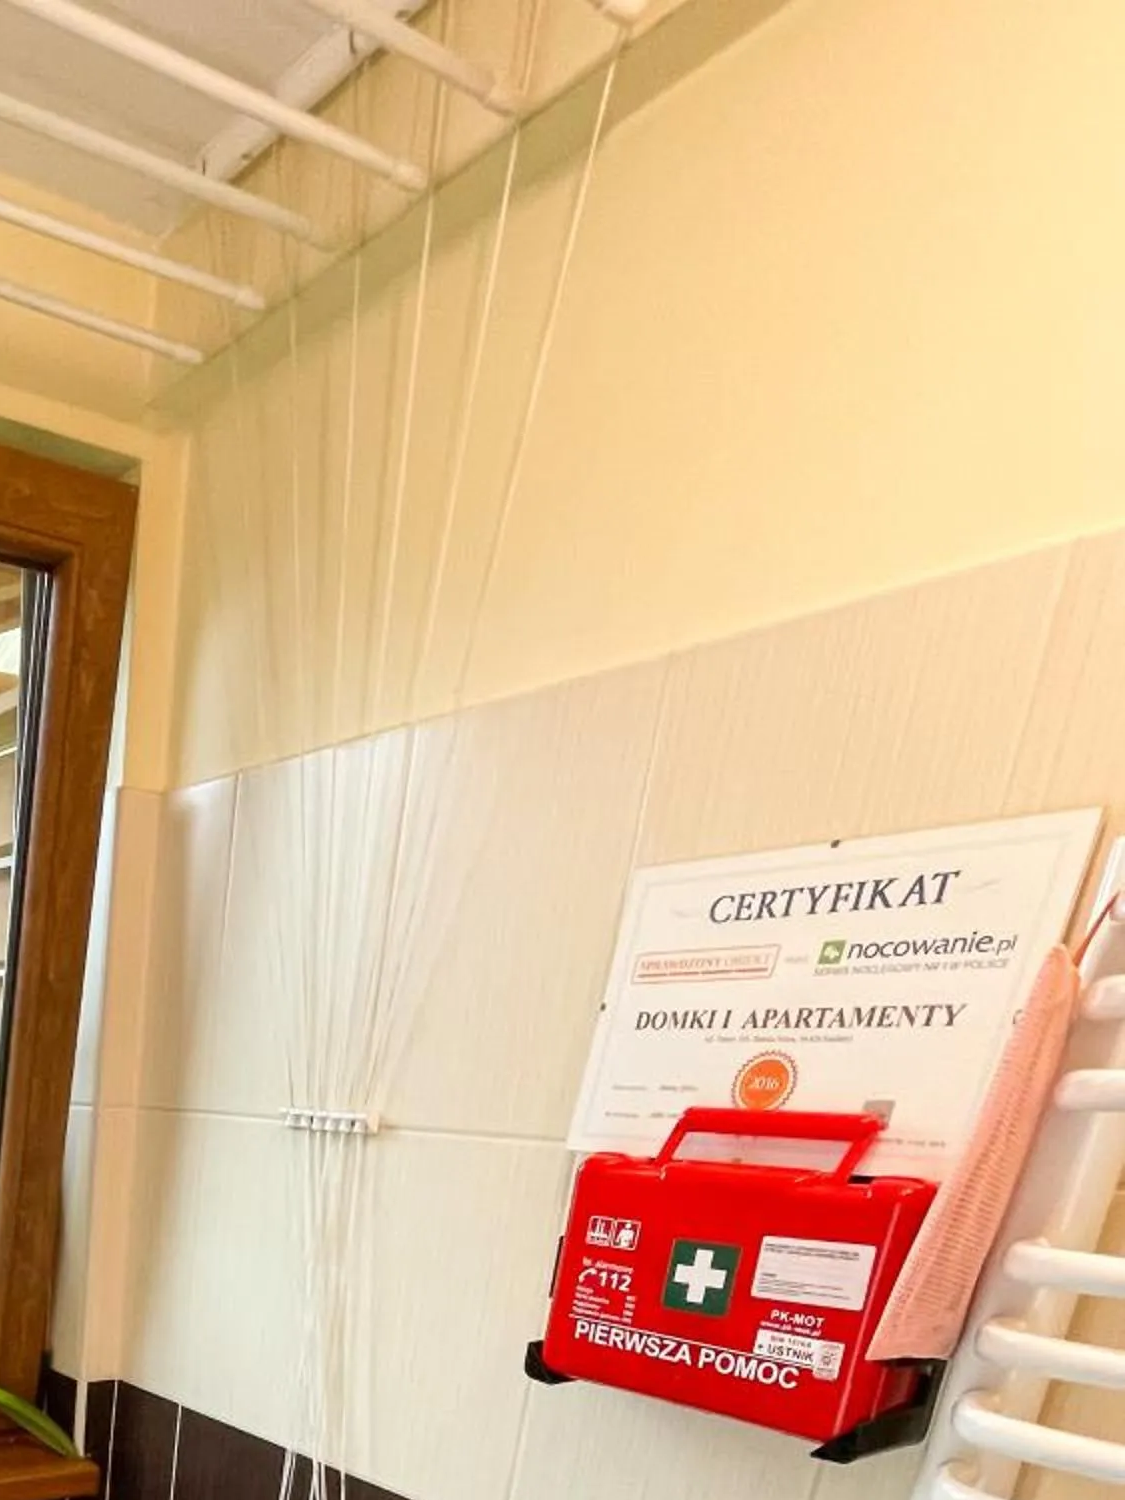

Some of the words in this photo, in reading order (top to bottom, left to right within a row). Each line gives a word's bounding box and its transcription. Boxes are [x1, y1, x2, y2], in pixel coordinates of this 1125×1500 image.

[709, 870, 962, 924] CERTYFIKAT
[847, 931, 1018, 960] nocowanie.pl
[635, 1009, 717, 1032] DOMKI
[721, 1009, 733, 1030] I
[741, 1003, 968, 1031] APARTAMENTY
[599, 1271, 632, 1292] 112
[770, 1309, 825, 1328] PK-MOT
[575, 1320, 693, 1366] PIERWSZA
[698, 1347, 800, 1389] POMOC
[767, 1343, 814, 1362] USTNIK
